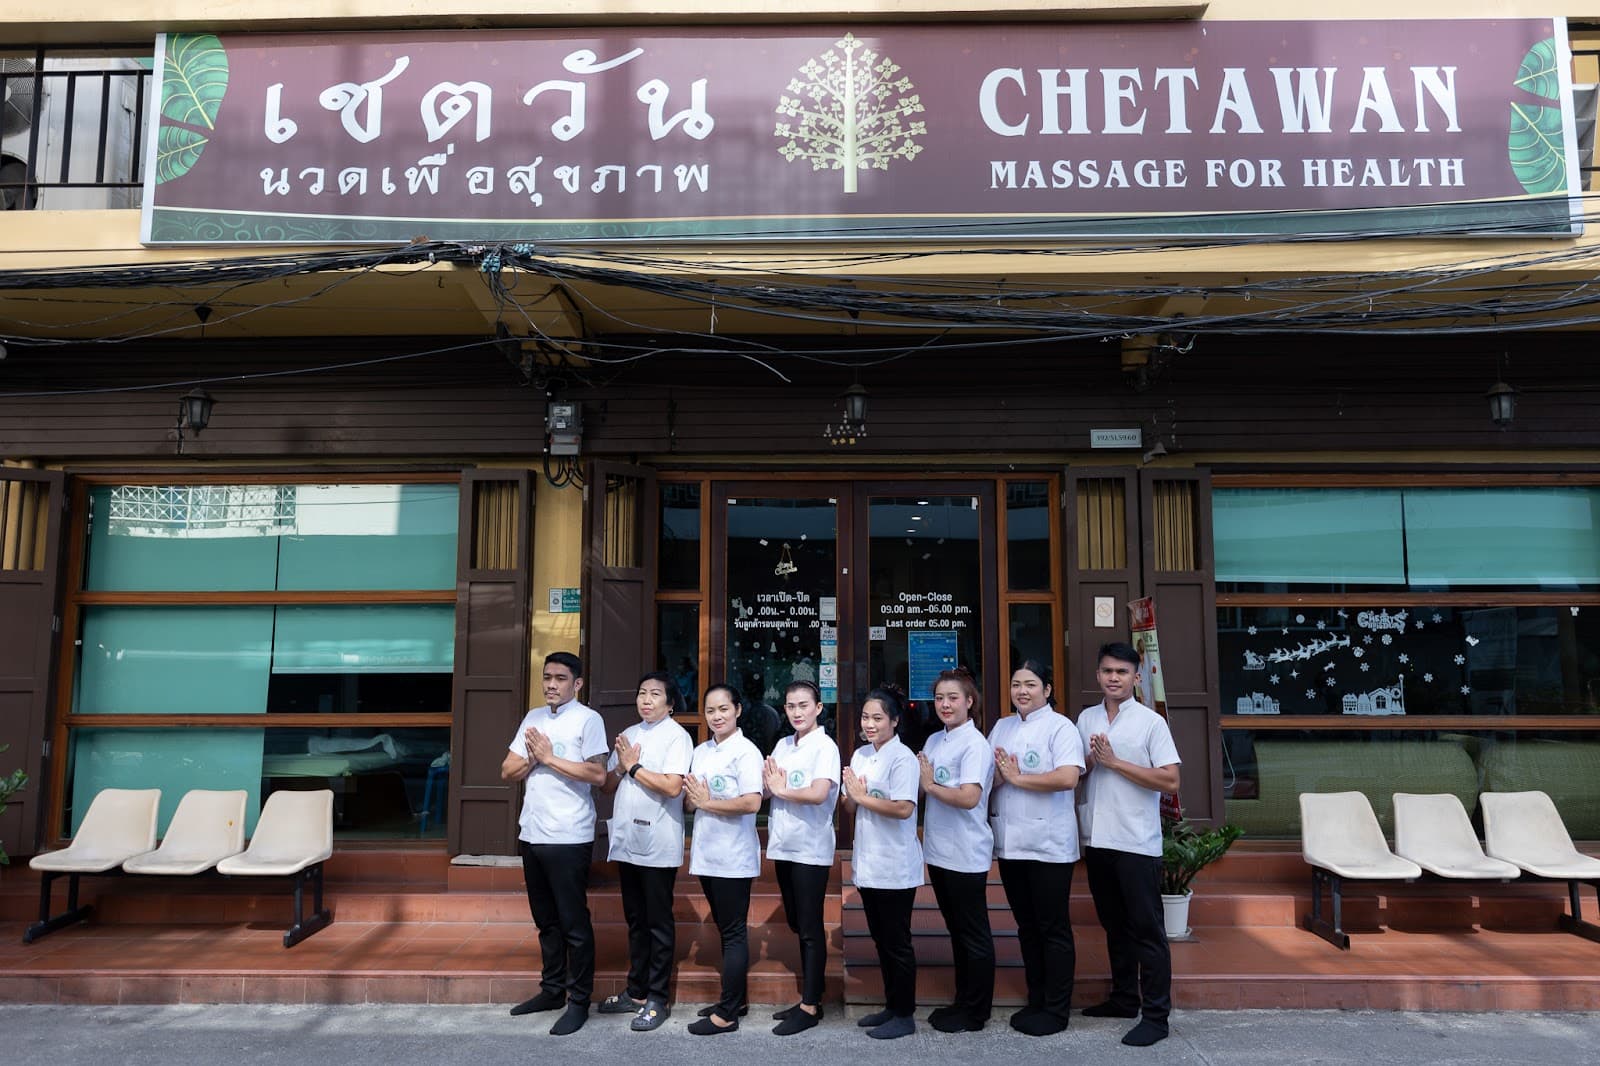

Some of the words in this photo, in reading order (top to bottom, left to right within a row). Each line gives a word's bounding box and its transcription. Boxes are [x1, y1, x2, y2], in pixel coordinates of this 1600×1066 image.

[265, 48, 715, 143] เชตวัน
[979, 65, 1463, 137] CHETAWAN
[260, 144, 709, 207] นวดเพื่อสุขภาพ
[990, 159, 1188, 190] MASSAGE
[1206, 158, 1286, 189] FOR
[1302, 157, 1466, 190] HEALTH
[880, 604, 905, 615] 09.00
[954, 605, 972, 616] pm.
[898, 591, 953, 604] Open-Close
[885, 618, 904, 628] Last
[905, 619, 927, 628] order
[928, 618, 950, 628] 05.00
[951, 620, 967, 630] pm.
